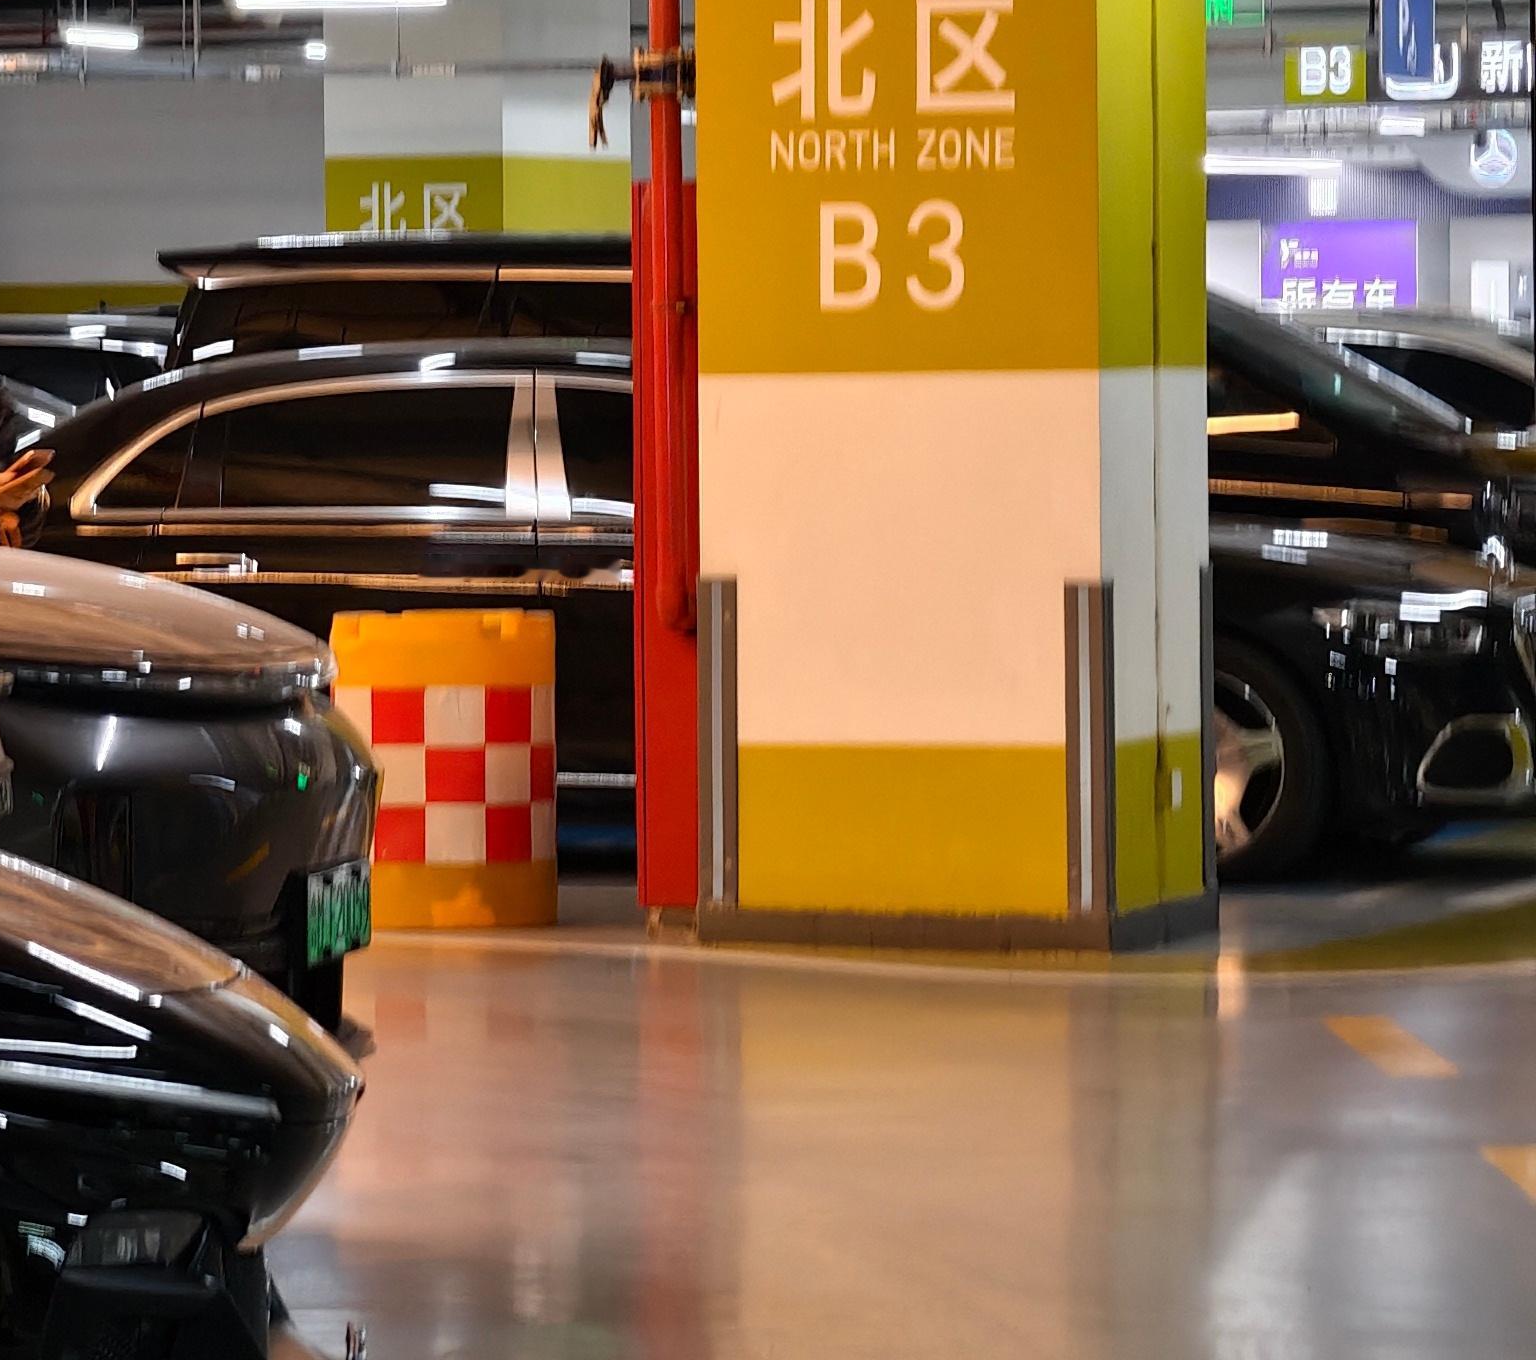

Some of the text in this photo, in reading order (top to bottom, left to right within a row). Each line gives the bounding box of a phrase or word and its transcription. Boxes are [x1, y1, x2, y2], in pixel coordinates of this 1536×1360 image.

[1299, 45, 1352, 96] B3
[1480, 40, 1532, 94] 新
[770, 126, 1015, 173] NORTH ZONE
[360, 180, 467, 240] 北区
